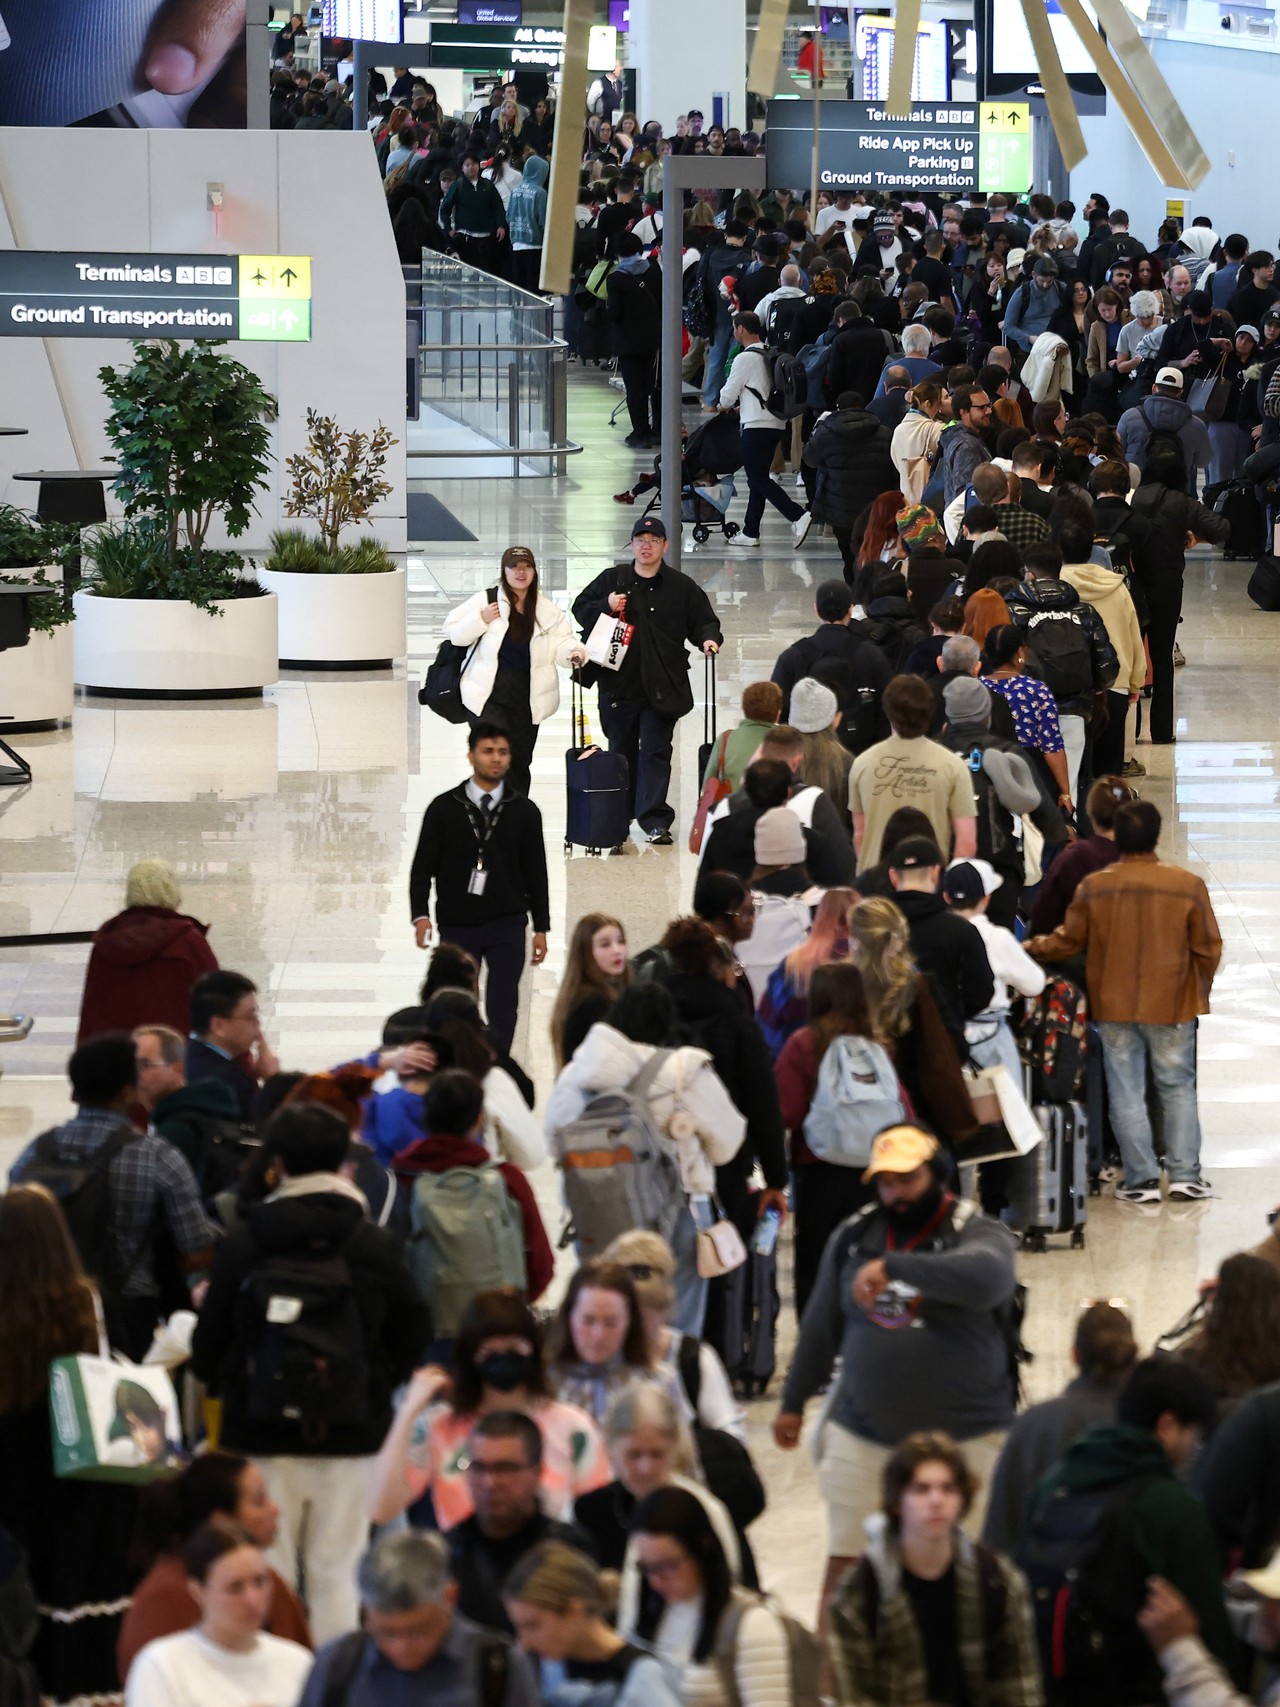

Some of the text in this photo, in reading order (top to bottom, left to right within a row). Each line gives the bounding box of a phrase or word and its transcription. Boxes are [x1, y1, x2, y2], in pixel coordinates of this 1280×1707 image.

[858, 135, 973, 153] Ride App Pick Up
[908, 155, 959, 171] Parking
[821, 171, 974, 187] Ground Transportation
[75, 263, 172, 284] Terminals
[11, 304, 233, 328] Ground Transportation
